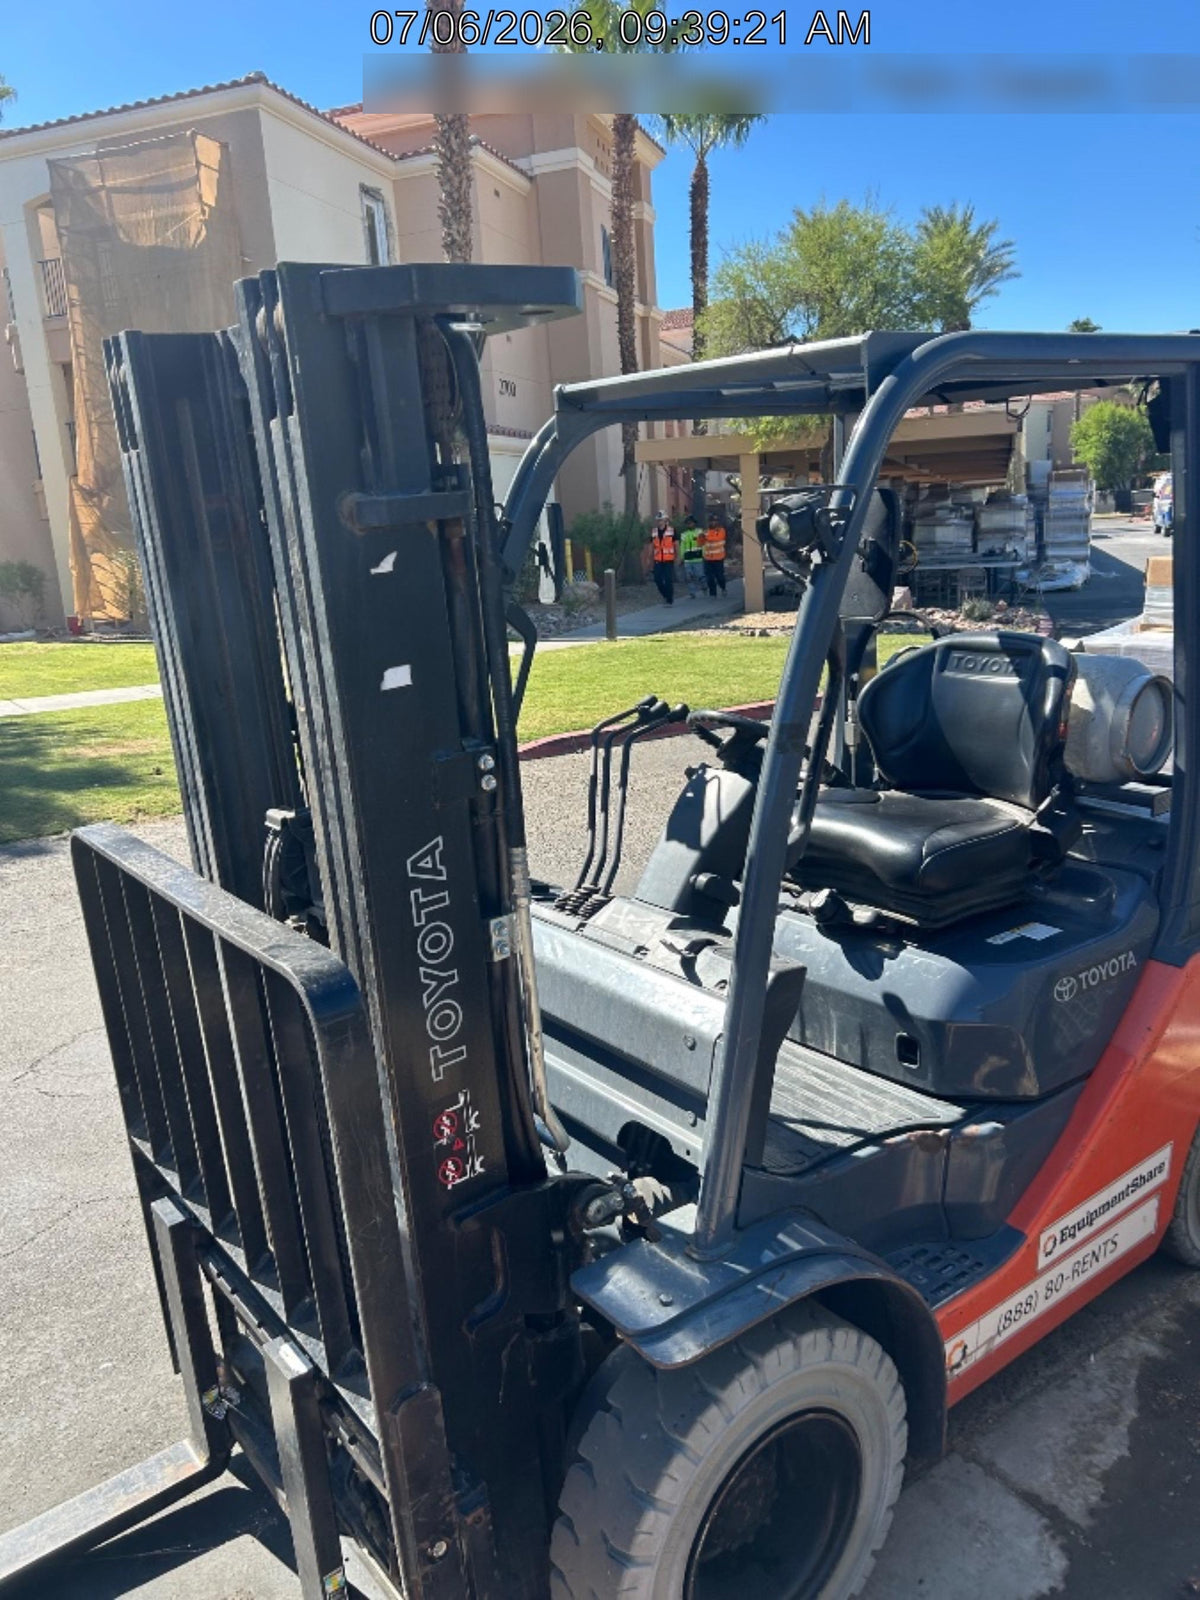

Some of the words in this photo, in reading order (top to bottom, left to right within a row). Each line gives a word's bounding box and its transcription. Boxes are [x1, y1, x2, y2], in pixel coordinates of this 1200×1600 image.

[406, 835, 468, 1083] TOYOTA
[1078, 950, 1137, 990] TOYOTA
[1059, 1159, 1166, 1245] EquipmentShare
[996, 1289, 1040, 1338] (888)
[1043, 1233, 1120, 1302] 80-RENTS
